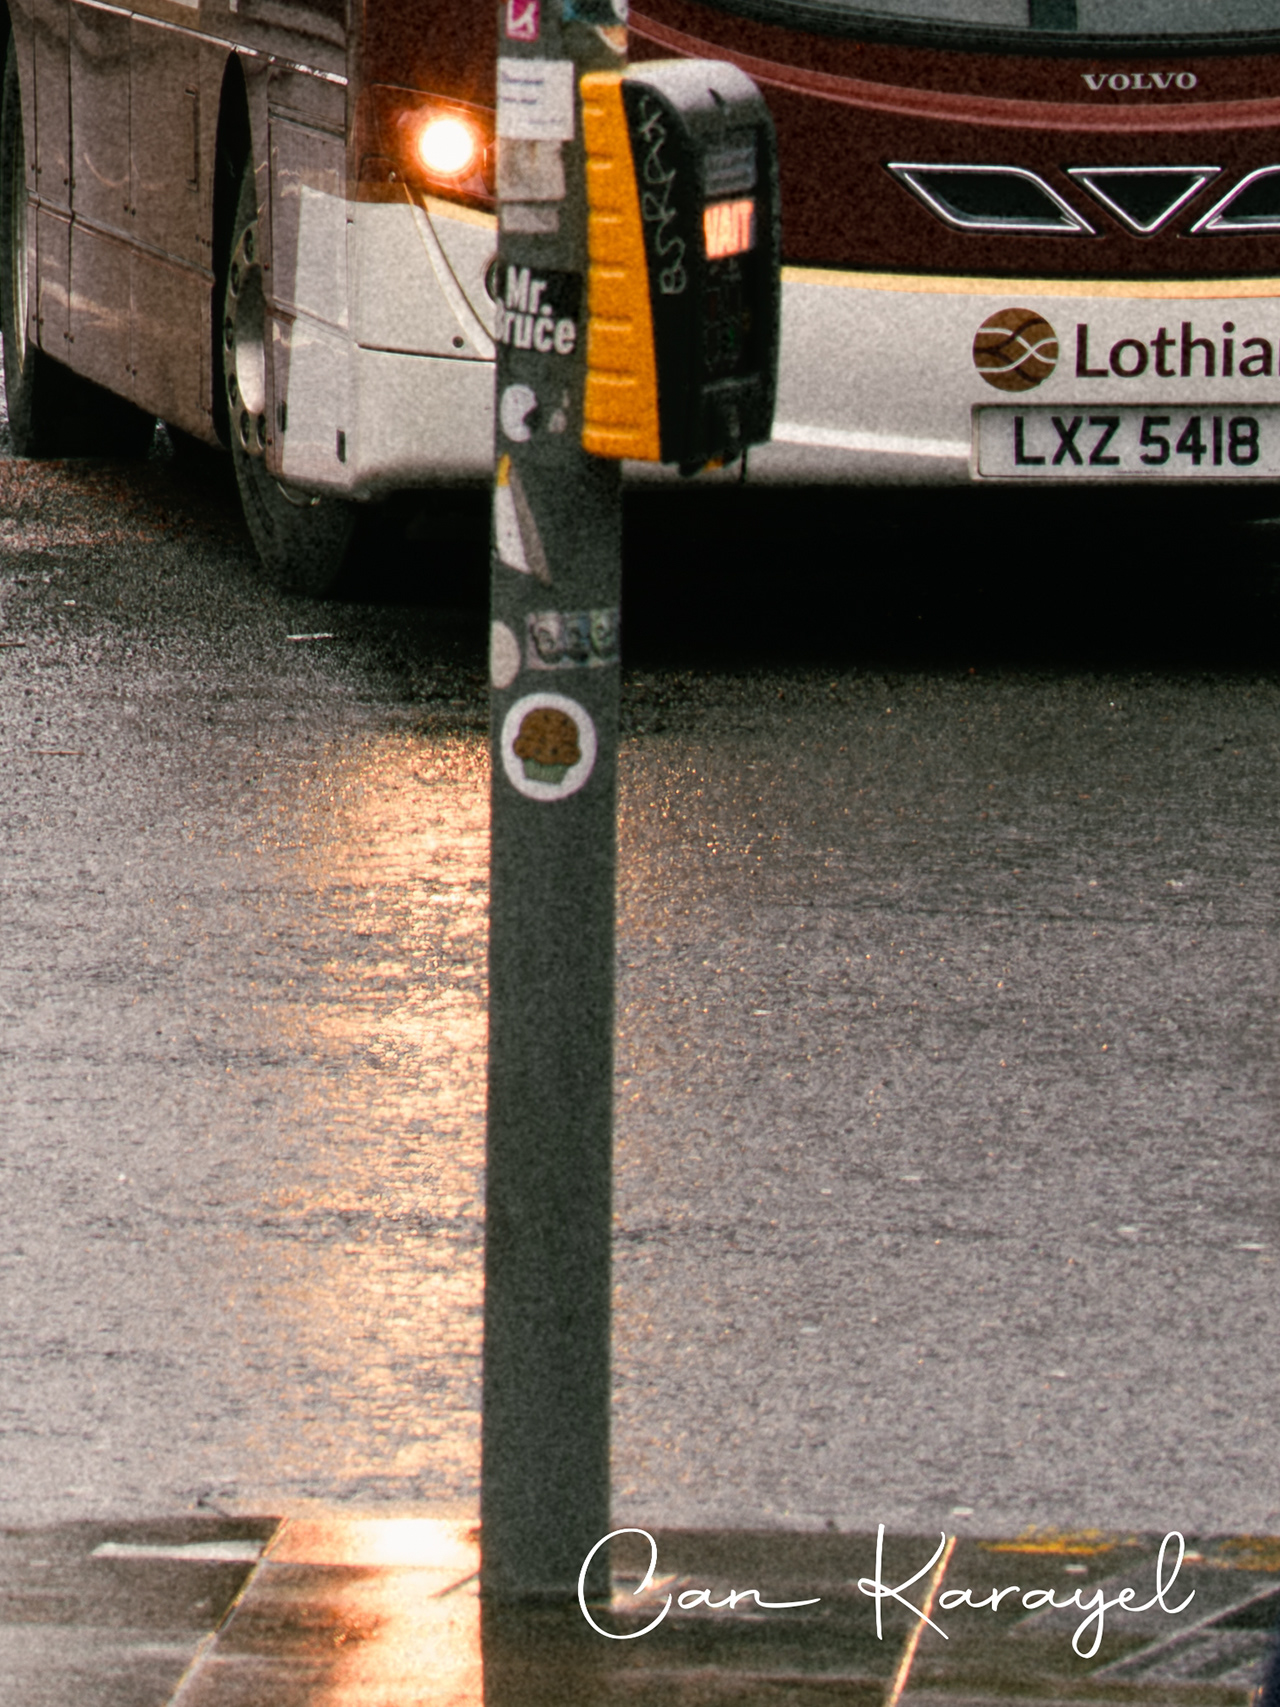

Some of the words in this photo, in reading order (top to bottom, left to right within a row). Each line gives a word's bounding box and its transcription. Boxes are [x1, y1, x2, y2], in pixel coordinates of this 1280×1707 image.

[1080, 71, 1198, 91] VOLVO
[703, 199, 755, 260] WAIT
[506, 266, 553, 316] Mr.
[1075, 320, 1280, 378] Lothia
[1013, 415, 1121, 466] LXZ
[1139, 415, 1260, 467] 5418
